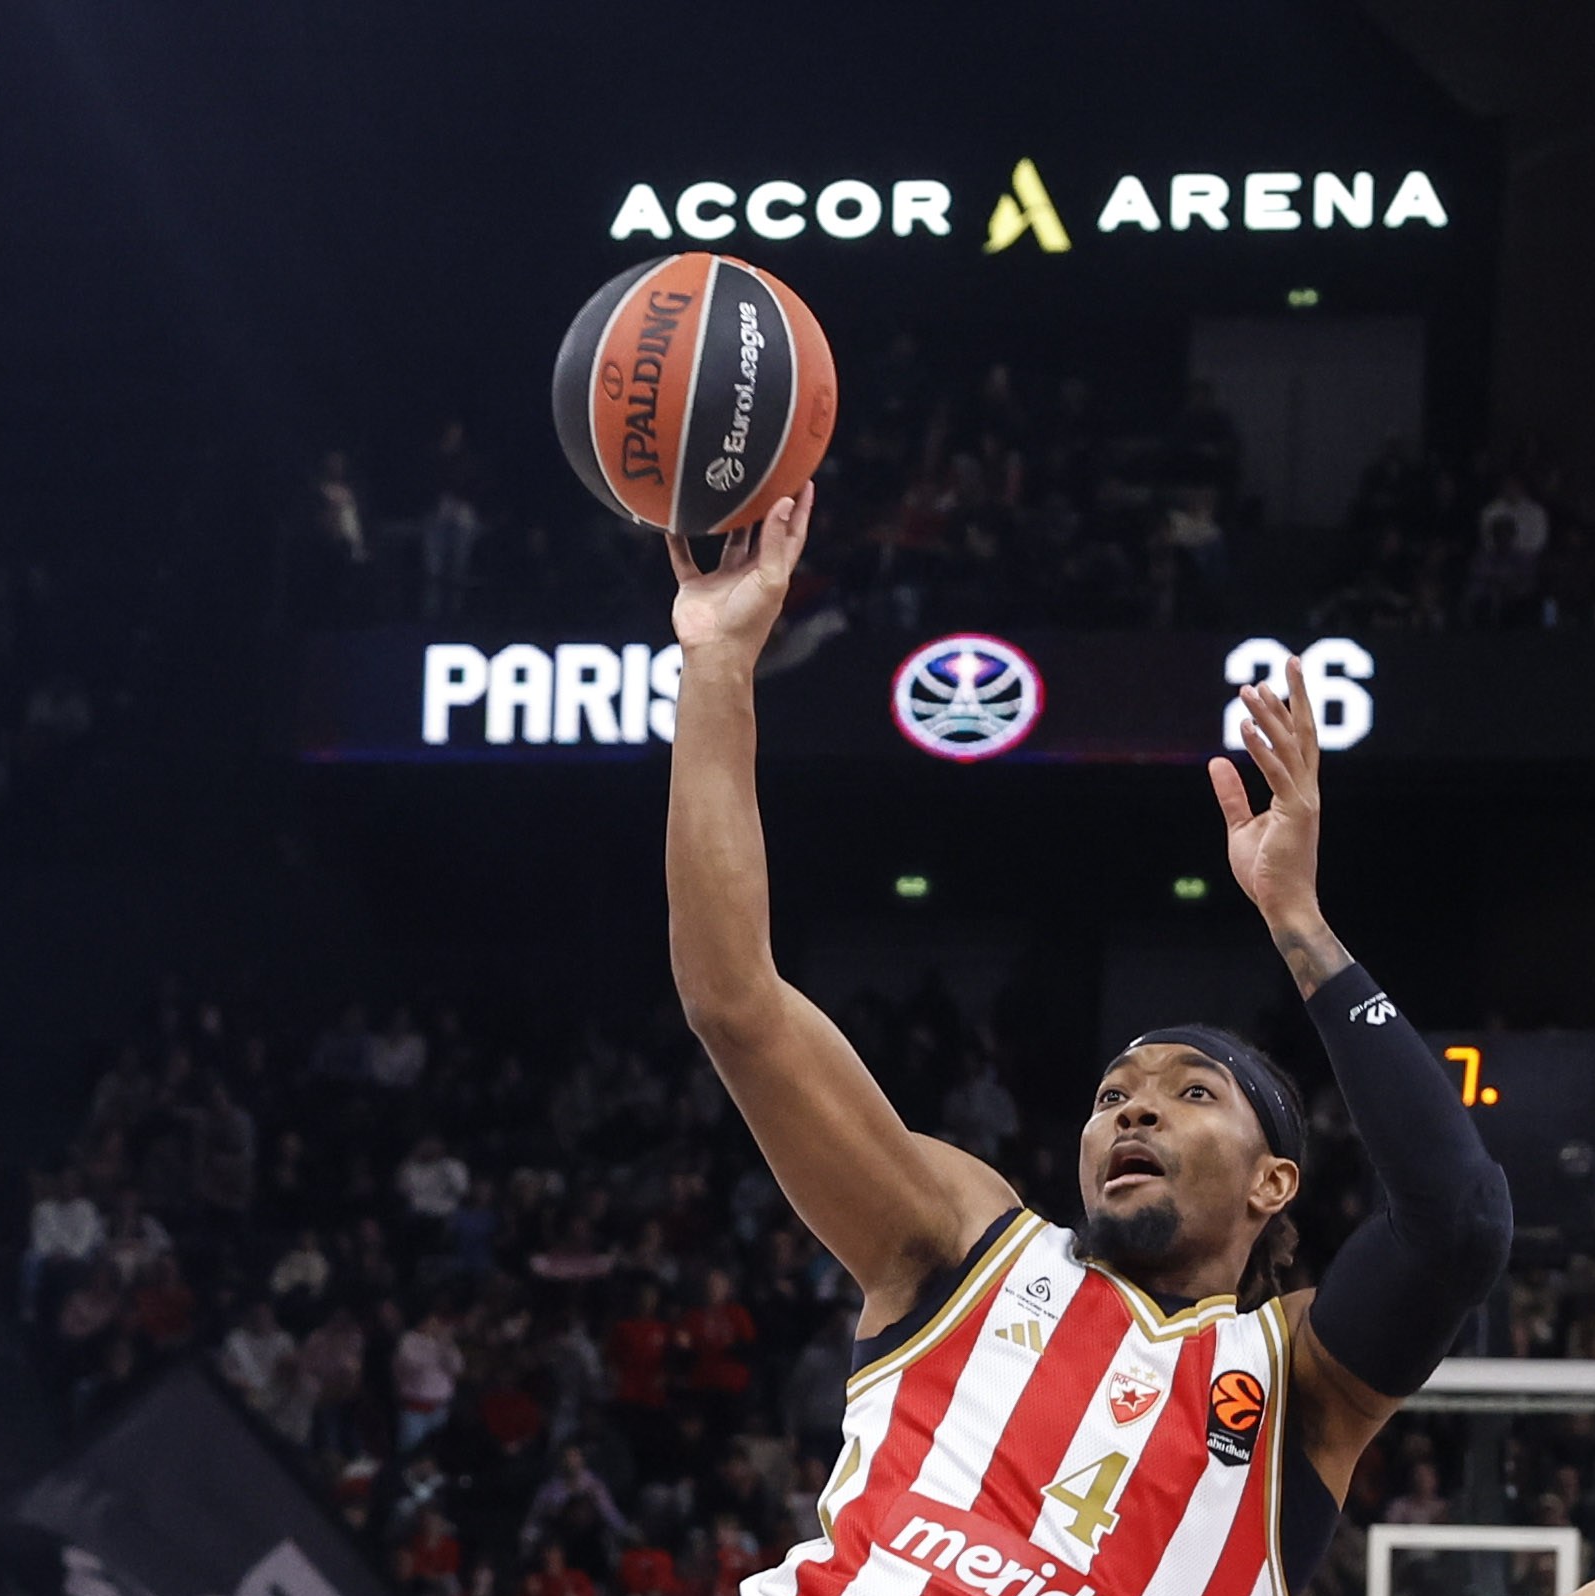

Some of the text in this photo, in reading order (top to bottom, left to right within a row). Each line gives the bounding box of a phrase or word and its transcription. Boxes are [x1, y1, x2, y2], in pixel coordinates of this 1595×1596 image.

[610, 179, 952, 241] ACCOR
[1097, 170, 1448, 233] ARENA
[622, 291, 692, 485] SPALDING
[1223, 637, 1375, 752] 26
[1043, 1450, 1130, 1550] 4
